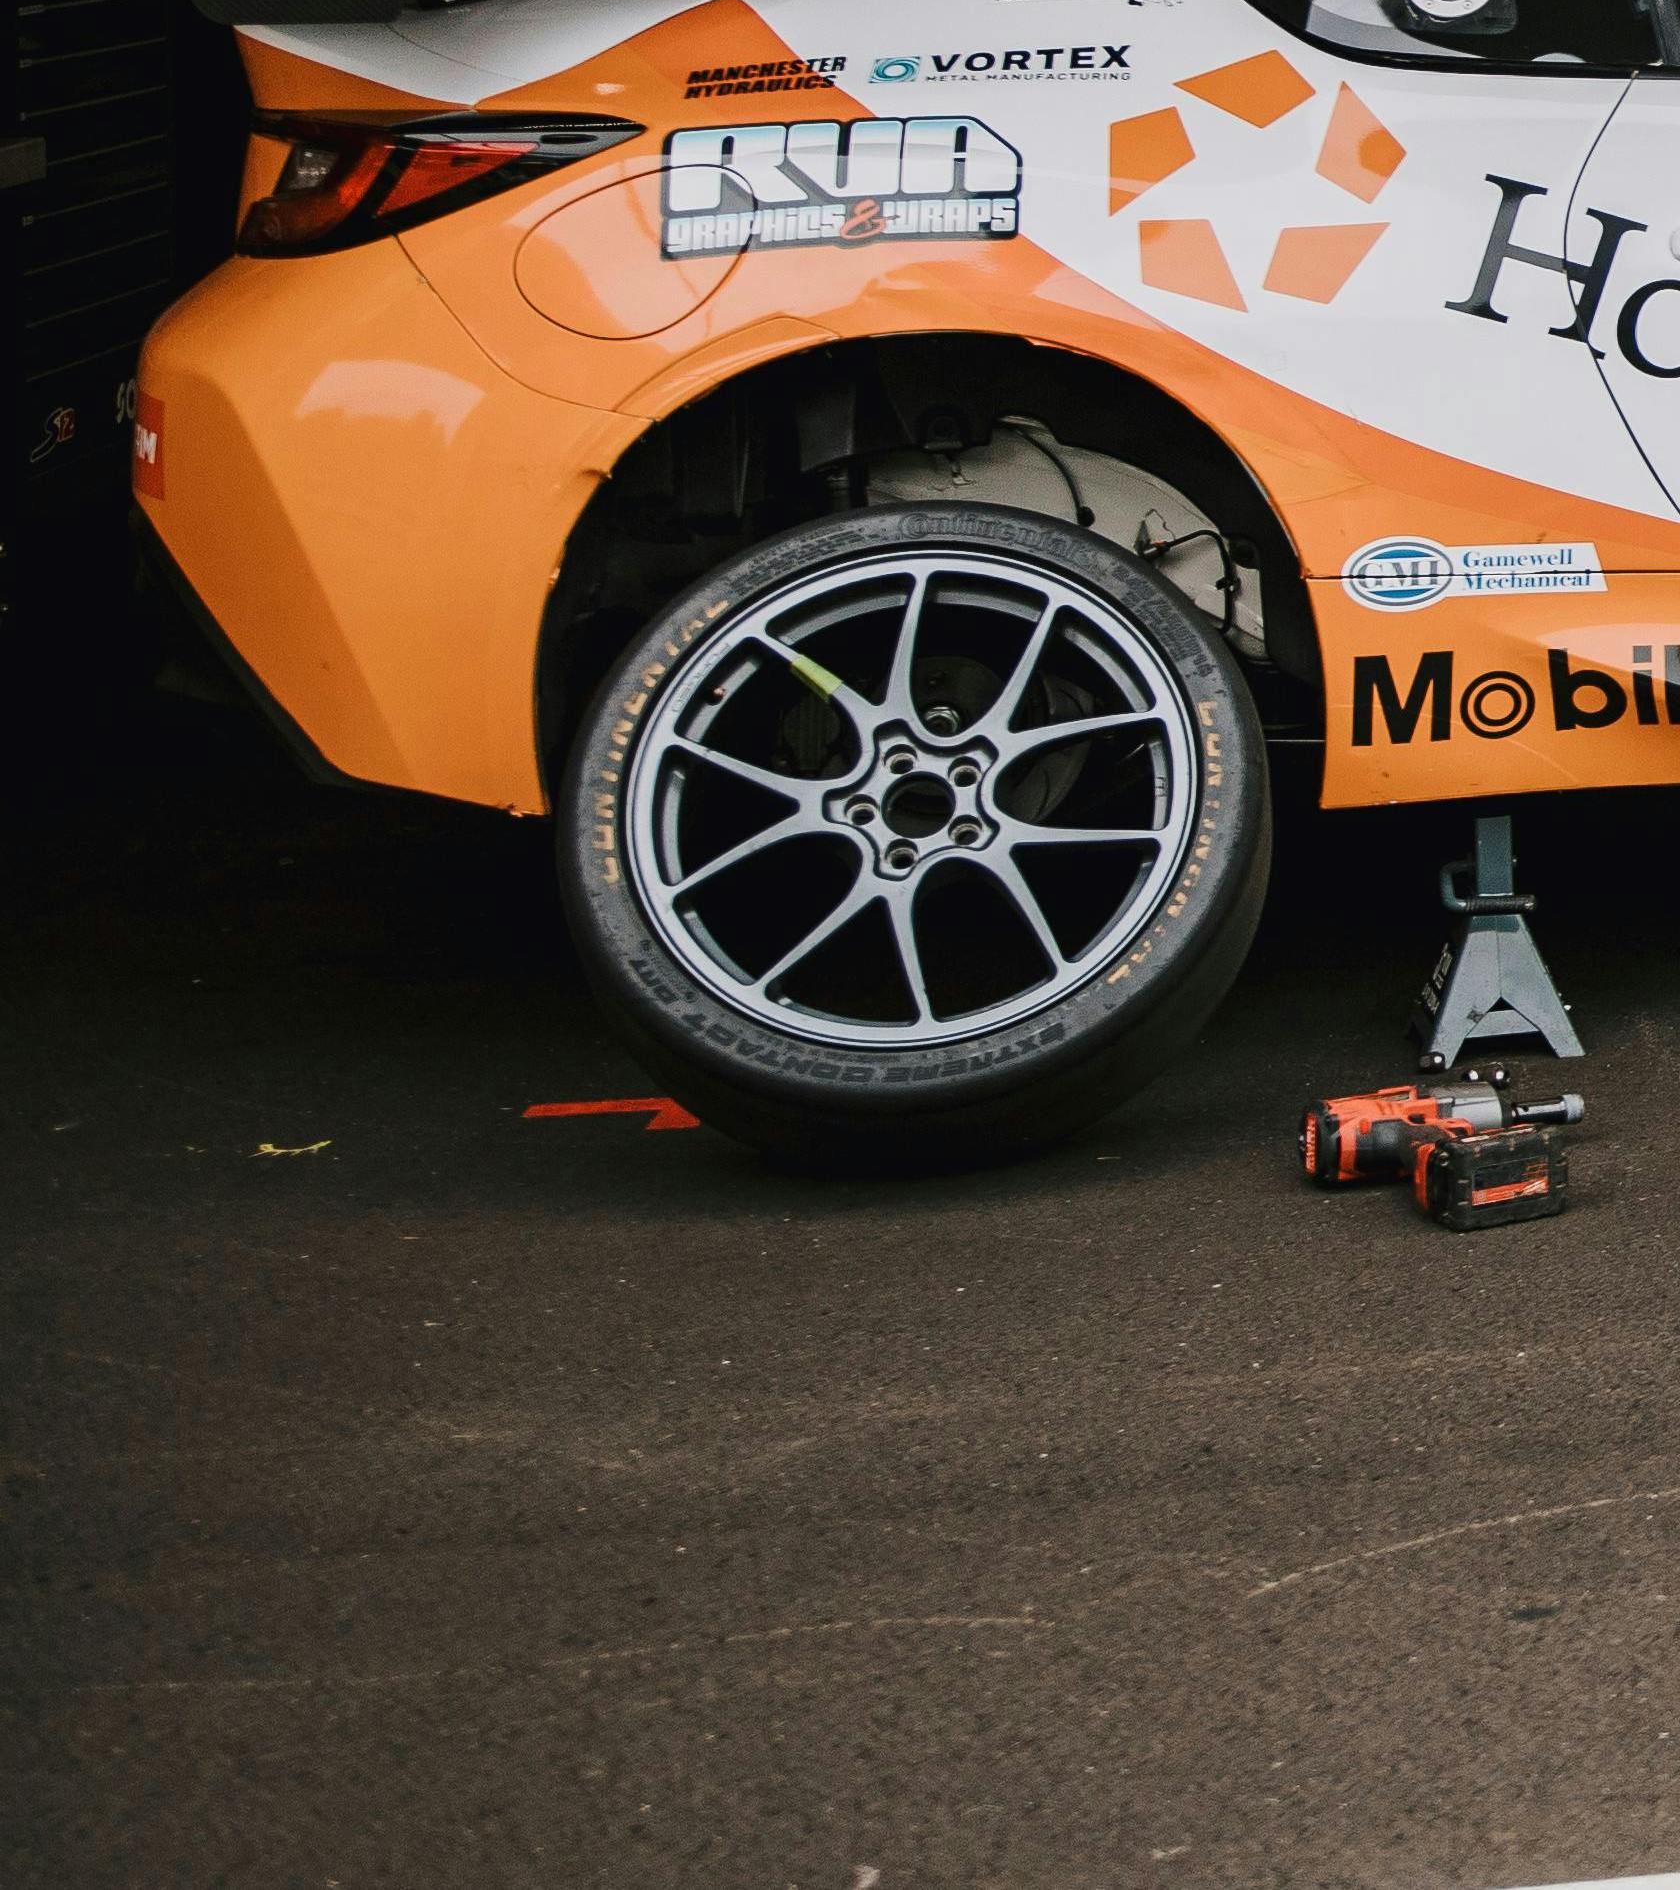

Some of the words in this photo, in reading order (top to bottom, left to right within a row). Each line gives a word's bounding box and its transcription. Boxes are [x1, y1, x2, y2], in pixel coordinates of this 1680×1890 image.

[686, 56, 847, 86] MANCHESTER
[931, 45, 1131, 71] VORTEX
[684, 74, 837, 100] HYDRAULICS
[926, 73, 970, 83] METAL
[983, 71, 1131, 83] MANUFACTURING
[884, 198, 1016, 235] WRAPS
[1462, 549, 1574, 571] Gamewell
[1356, 561, 1440, 589] GMI
[1462, 569, 1593, 592] Mechanical
[881, 1021, 1068, 1084] EXTREME
